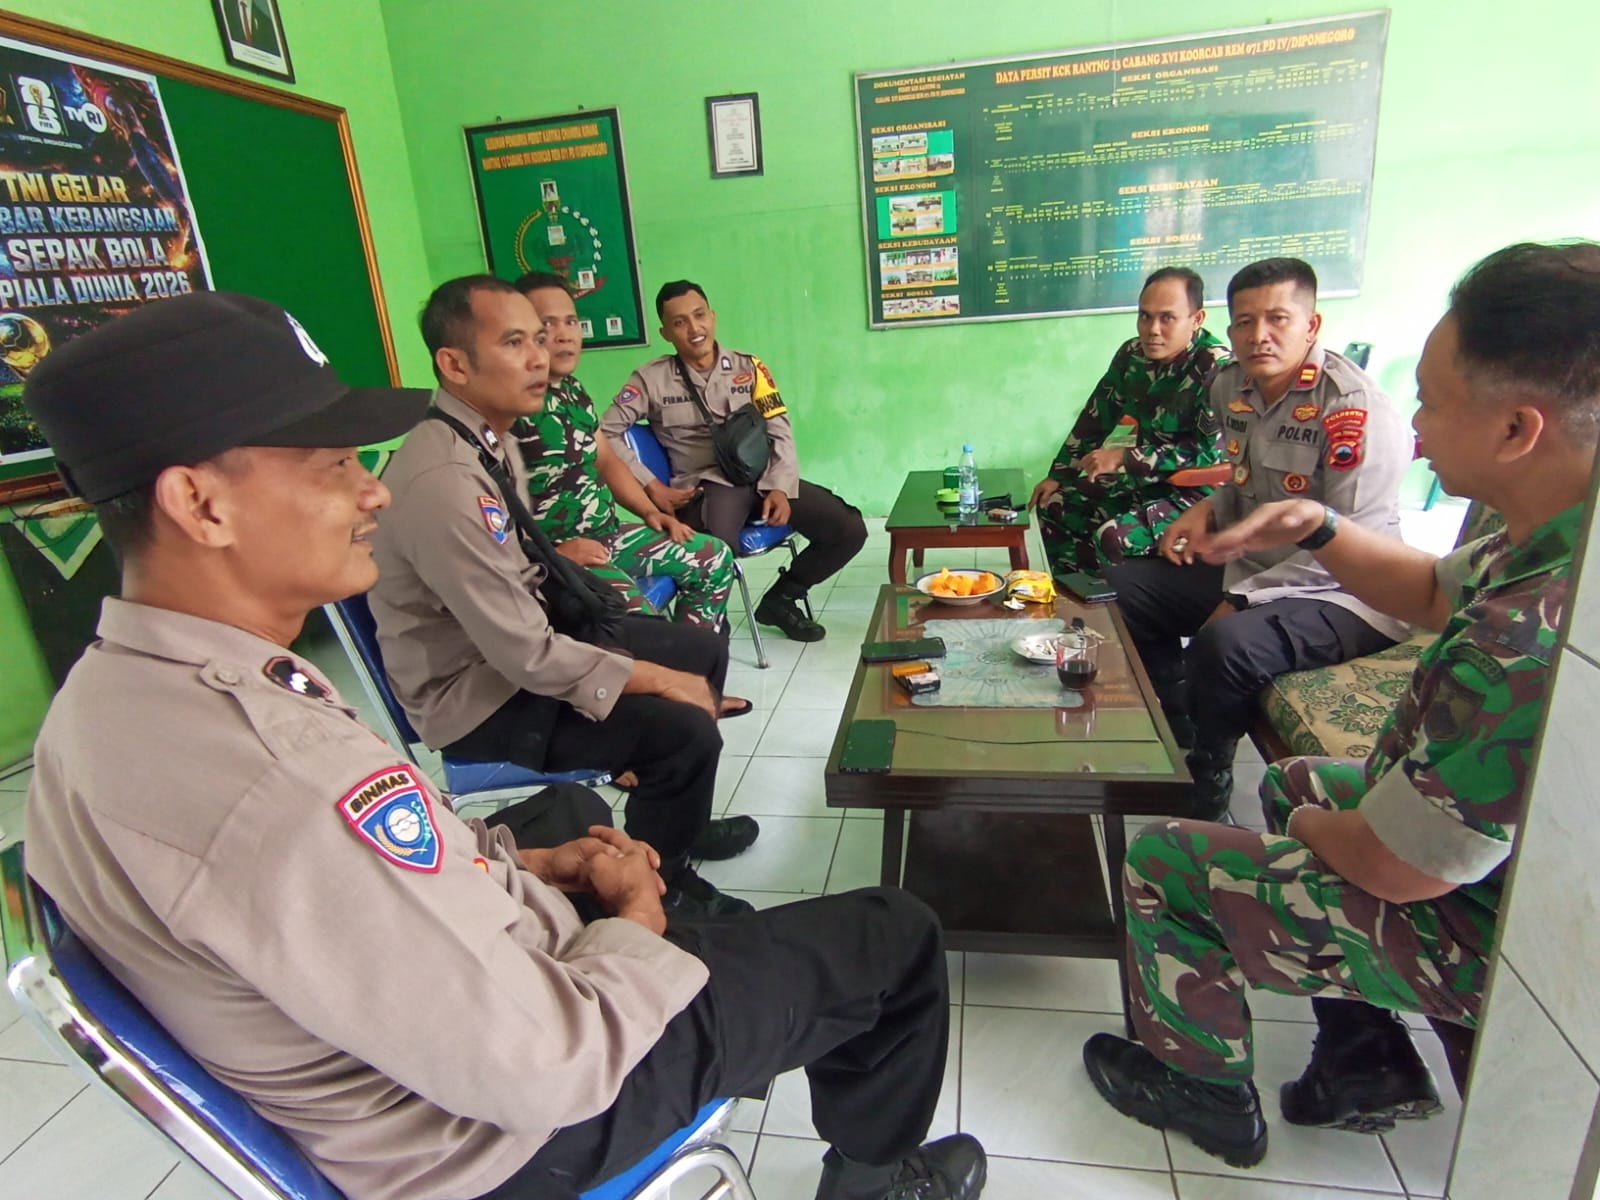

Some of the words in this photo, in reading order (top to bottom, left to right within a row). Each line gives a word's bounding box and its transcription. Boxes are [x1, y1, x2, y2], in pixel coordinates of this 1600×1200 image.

[995, 70, 1020, 84] DATA
[1020, 66, 1052, 82] PERSIT
[1052, 63, 1072, 78] KCK
[1122, 53, 1160, 70] CABANG
[1160, 50, 1179, 65] XVI
[1179, 45, 1224, 62] KOORCAB
[1224, 41, 1245, 57] REM
[1262, 38, 1276, 52] PD
[1276, 27, 1356, 52] IV/DIPONEGORO
[1121, 73, 1151, 83] SEKSI
[1155, 65, 1218, 79] ORGANISASI
[871, 125, 895, 135] SEKSI
[895, 120, 947, 132] ORGANISASI
[1131, 129, 1161, 139] SEKSI
[1162, 123, 1210, 136] EKONOMI
[1, 172, 51, 203] TNI
[51, 173, 131, 204] GELAR
[875, 186, 898, 196] SEKSI
[899, 182, 937, 193] EKONOMI
[1119, 185, 1147, 195] SEKSI
[48, 206, 180, 233] KEBANGSAAN
[878, 241, 902, 251] SEKSI
[902, 236, 958, 249] KEBUDAYAAN
[1130, 237, 1160, 246] SEKSI
[8, 238, 107, 272] SEPAK
[103, 237, 170, 269] BOLA
[0, 277, 73, 309] PIALA
[71, 275, 143, 304] DUNIA
[141, 271, 193, 299] 2026
[1277, 425, 1319, 444] POLRI
[350, 773, 410, 813] BINMAS
